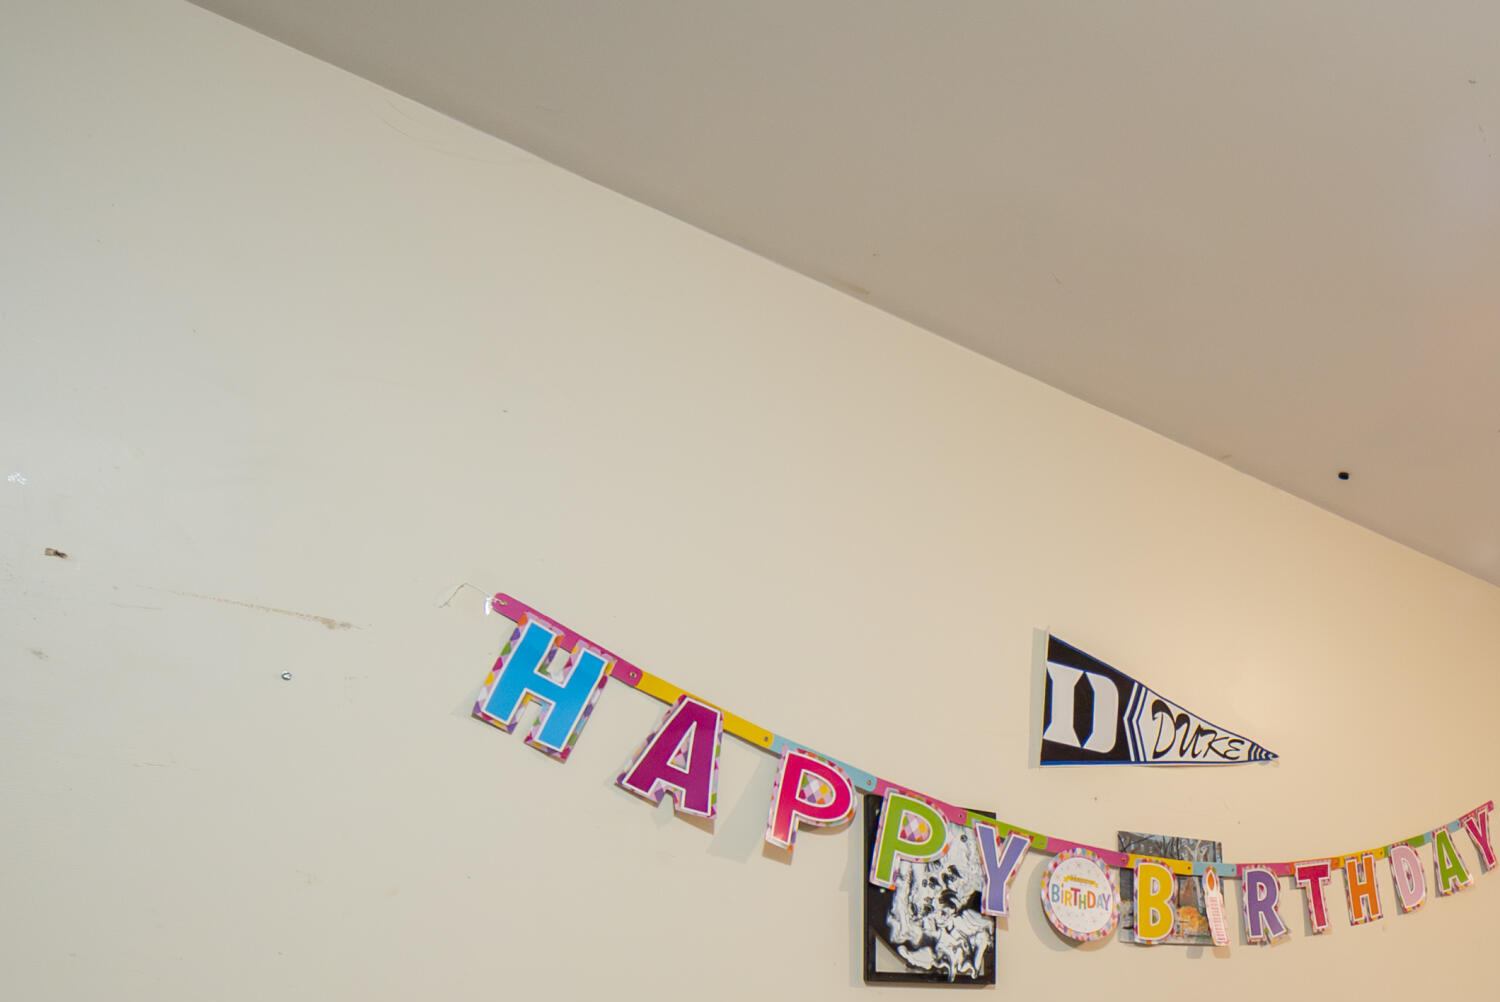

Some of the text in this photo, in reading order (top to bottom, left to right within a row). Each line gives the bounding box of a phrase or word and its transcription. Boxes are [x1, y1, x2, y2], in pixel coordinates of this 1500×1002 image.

[1042, 660, 1119, 754] D
[1151, 698, 1246, 761] DUKE
[475, 614, 1499, 946] HAPPY BIRTHDAY
